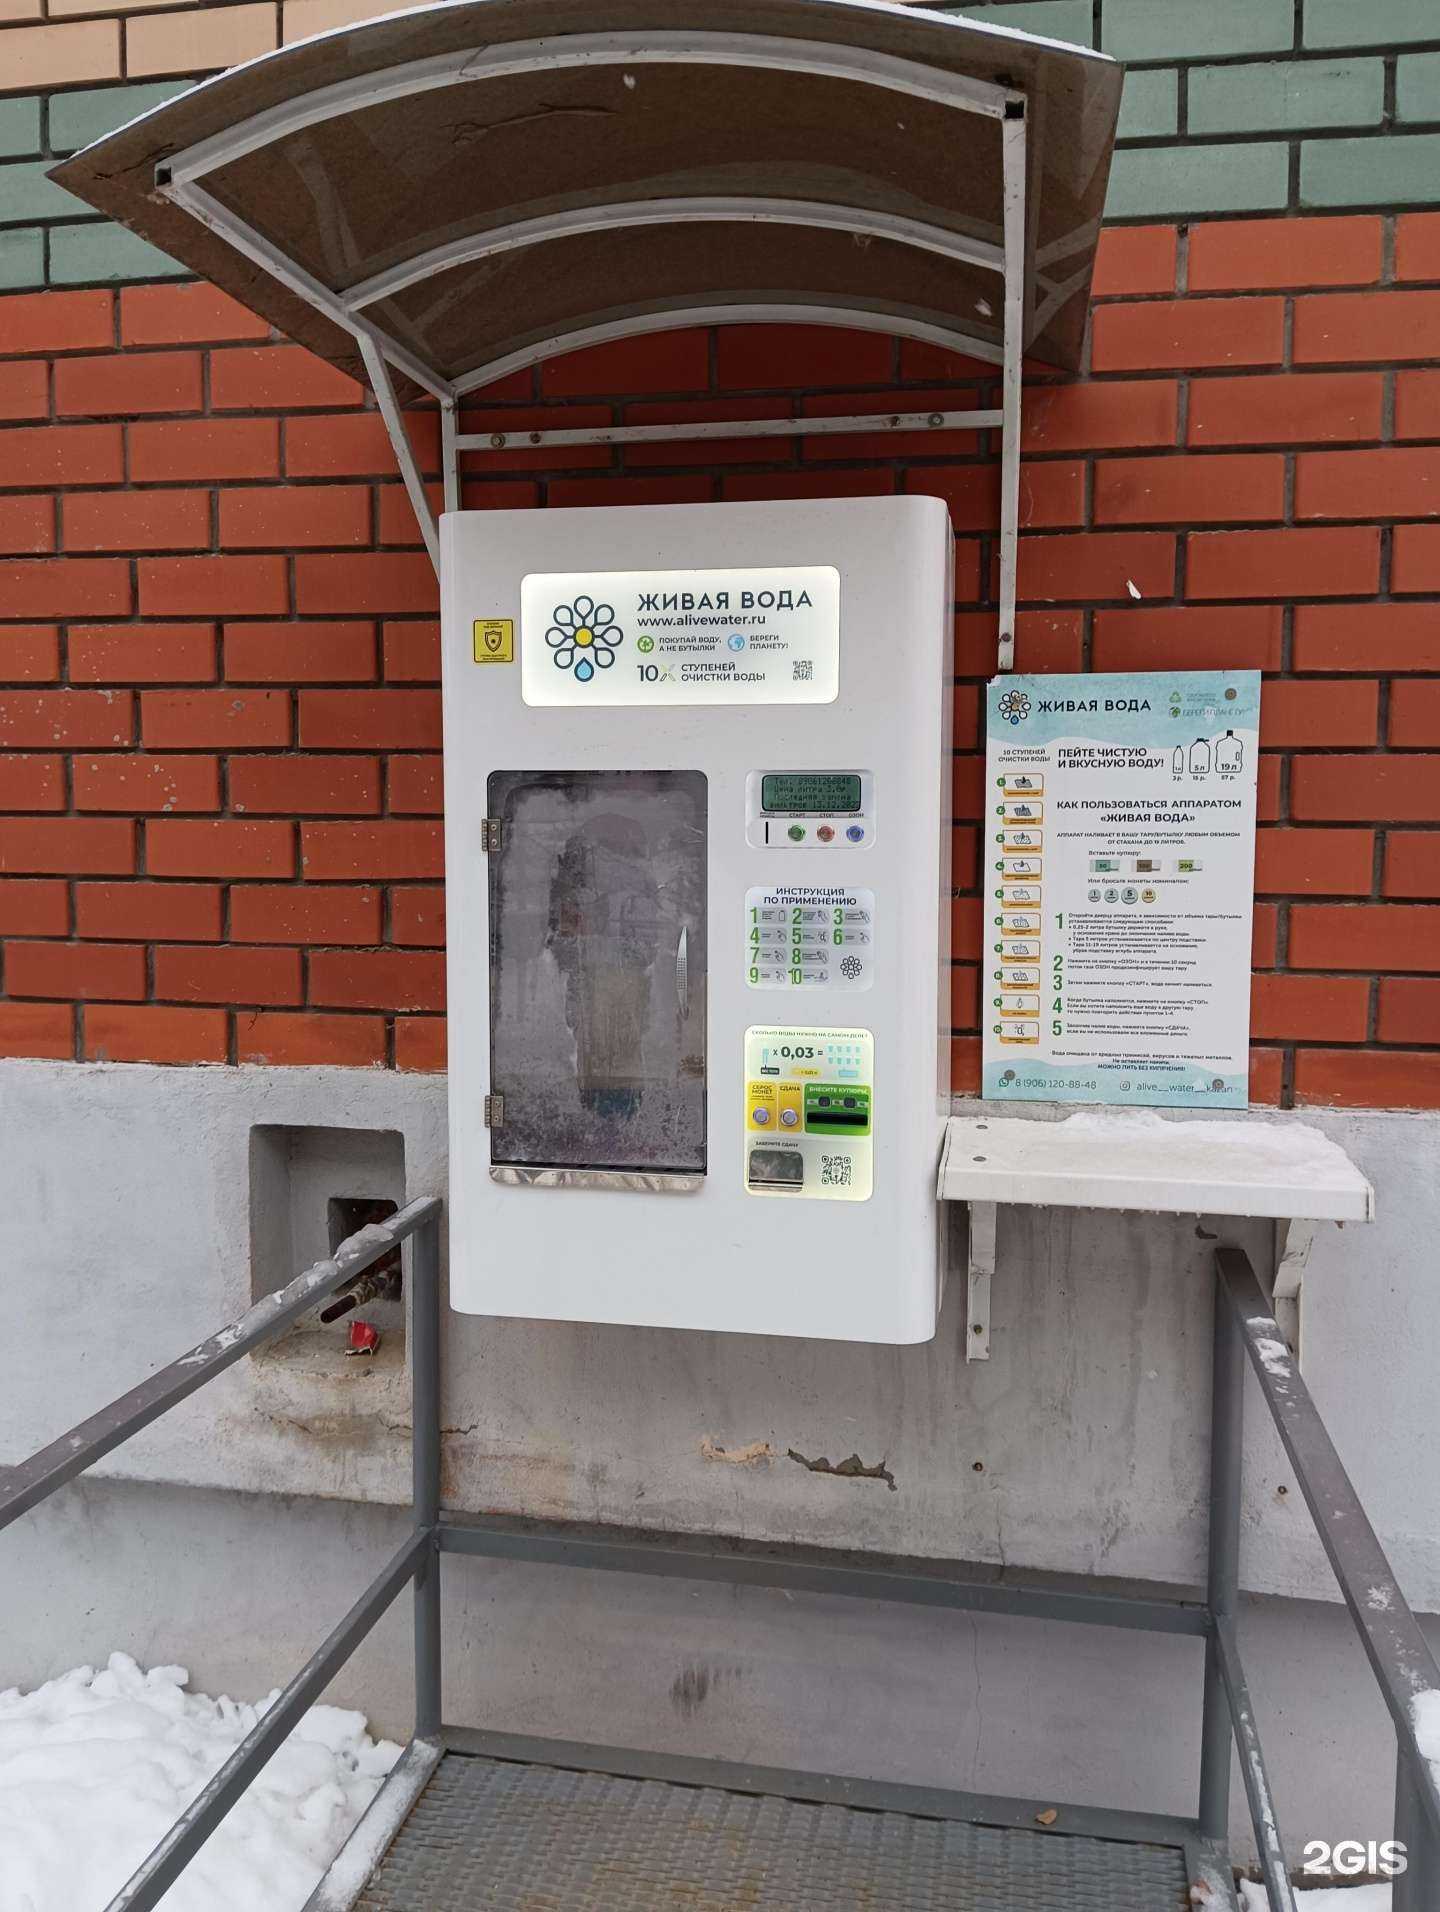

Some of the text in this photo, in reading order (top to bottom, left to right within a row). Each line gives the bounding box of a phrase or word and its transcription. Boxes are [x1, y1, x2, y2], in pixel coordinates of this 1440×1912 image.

[637, 590, 813, 611] ЖИВАЯ ВОДА
[637, 615, 766, 626] www.alivewater.ru
[659, 635, 722, 644] ПОКУПАЙ ВОДУ,
[681, 662, 736, 671] СТУПЕНЕЙ
[681, 673, 765, 682] ОЧИСТКИ ВОДЫ
[1038, 699, 1151, 712] ЖИВАЯ ВОДА
[1058, 747, 1147, 757] ПЕЙТЕ ЧИСТУЮ
[1058, 758, 1164, 769] И ВКУСНУЮ ВОДУ!
[1057, 800, 1241, 809] КАК ПОЛЬЗОВАТЬСЯ АППАРАТОМ
[1100, 814, 1195, 823] «ЖИВАЯ ВОДА»
[776, 888, 845, 896] ИНСТРУКЦИЯ
[781, 897, 857, 905] ПРИМЕНЕНИЮ
[750, 907, 757, 924] 1
[792, 907, 802, 925] 2
[833, 908, 843, 925] 3
[1056, 913, 1063, 929] 1
[750, 927, 760, 944] 4
[792, 928, 802, 944] 5
[833, 929, 843, 945] 6
[750, 947, 760, 964] 7
[791, 948, 801, 965] 8
[1053, 955, 1063, 971] 2
[750, 967, 759, 984] 9
[788, 968, 802, 984] 10
[1053, 975, 1062, 991] 3
[1052, 997, 1063, 1013] 4
[1052, 1020, 1062, 1036] 5
[780, 1046, 814, 1060] 0,03
[1015, 1078, 1097, 1090] 8 (906) 120-88-48
